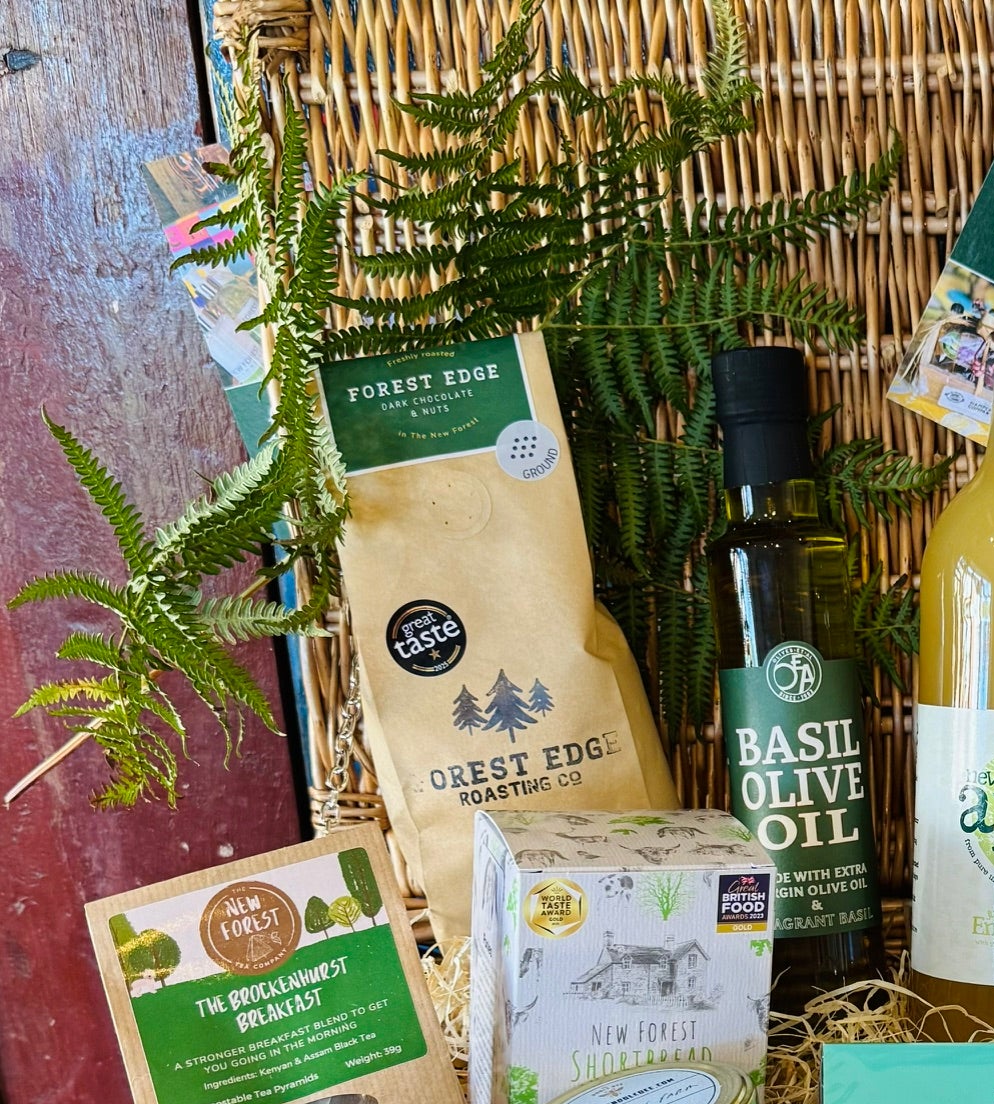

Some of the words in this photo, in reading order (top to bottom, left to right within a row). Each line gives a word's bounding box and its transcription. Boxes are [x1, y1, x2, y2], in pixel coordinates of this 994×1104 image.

[347, 373, 432, 402] FOREST
[444, 364, 500, 385] EDGE
[381, 398, 409, 412] DARK
[413, 389, 474, 405] CHOCOLATE
[411, 409, 418, 418] &
[422, 404, 449, 416] NUTS
[522, 447, 558, 480] GROUND
[393, 617, 461, 659] taste
[401, 612, 437, 638] great
[736, 719, 860, 766] BASIL
[742, 762, 864, 811] OLIVE
[758, 808, 859, 850] OIL
[794, 869, 831, 883] WITH
[834, 863, 868, 878] EXTRA
[721, 892, 766, 902] BRITISH
[727, 882, 760, 894] Great
[807, 882, 848, 896] OLIVE
[850, 878, 868, 890] OIL
[224, 894, 261, 917] NEW
[721, 901, 765, 914] FOOD
[775, 914, 836, 930] AGRANT
[839, 907, 873, 924] BASIL
[220, 907, 279, 940] FOREST
[732, 924, 752, 932] GOLD
[195, 998, 227, 1018] THE
[227, 956, 349, 1012] BROCKENHURST
[235, 988, 323, 1034] BREAKFAST
[174, 1063, 183, 1071] A
[185, 1047, 246, 1069] STRONGER
[249, 1025, 311, 1052] BREAKFAST
[313, 1013, 349, 1030] BLEND
[351, 1007, 366, 1018] TO
[369, 999, 389, 1013] GET
[592, 1023, 628, 1046] NEW
[639, 1020, 697, 1043] FOREST
